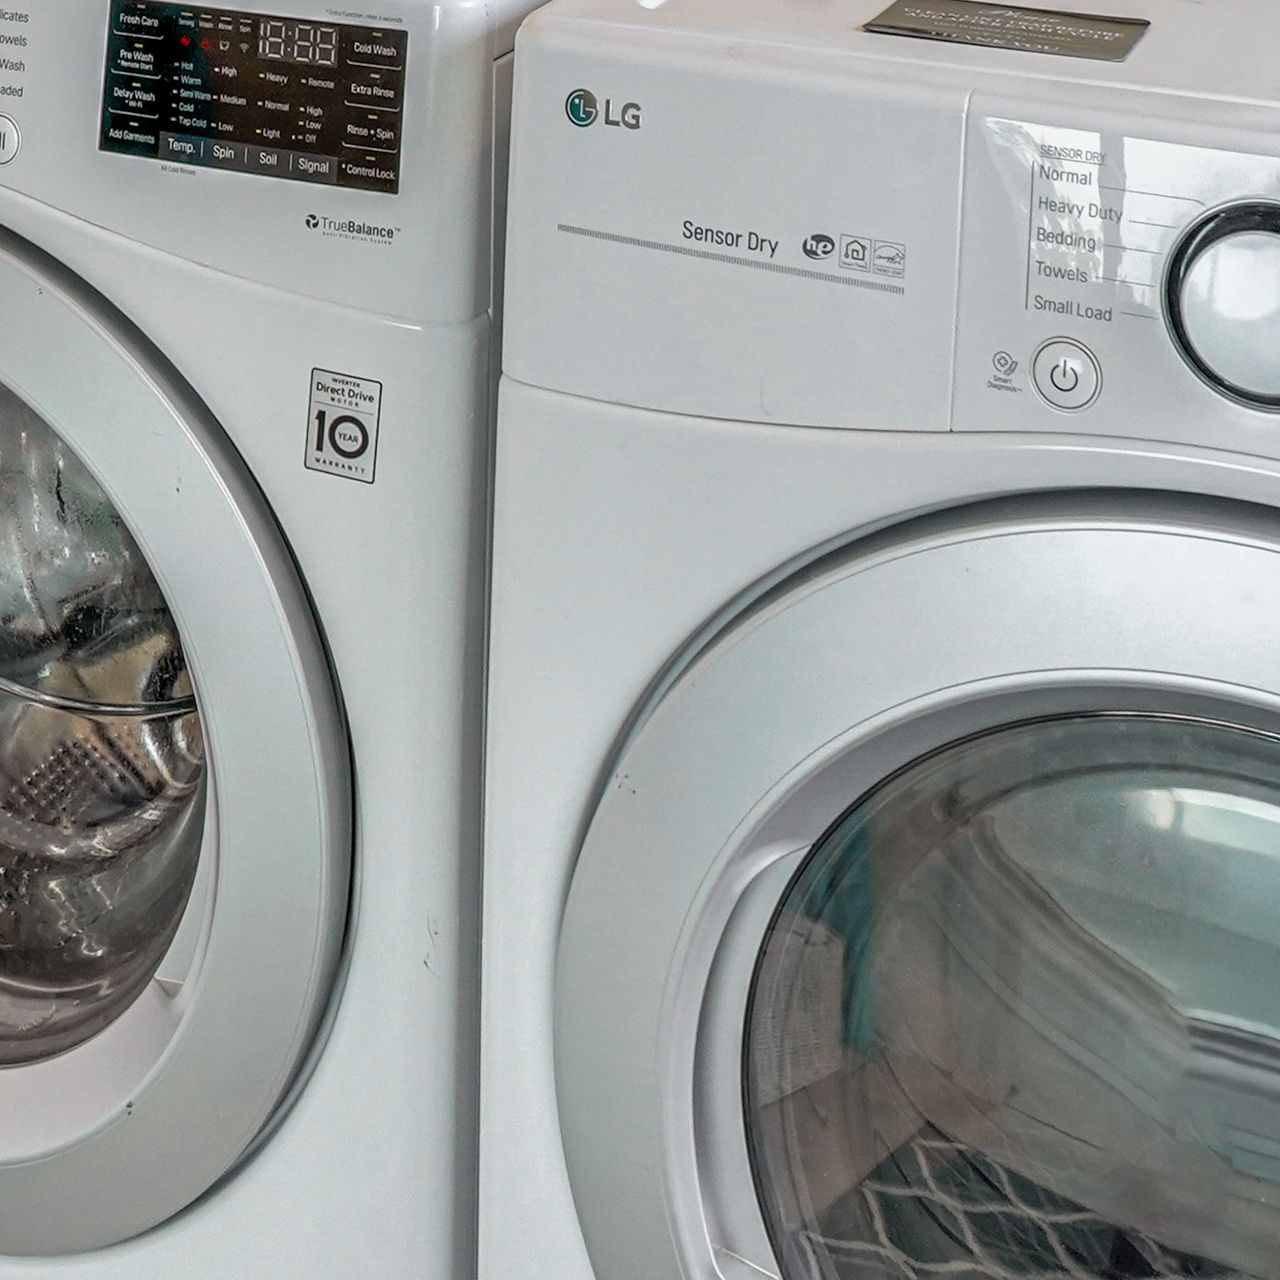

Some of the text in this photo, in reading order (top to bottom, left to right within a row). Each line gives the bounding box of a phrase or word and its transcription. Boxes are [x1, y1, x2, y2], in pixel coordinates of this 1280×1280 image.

[120, 12, 159, 27] Fresh Care
[120, 49, 154, 62] Pre Wash
[353, 42, 397, 56] Cold Wash
[0, 58, 25, 72] Wash
[221, 66, 238, 77] High
[181, 75, 202, 86] Warm
[266, 72, 289, 85] Heavy
[308, 78, 335, 89] Remote
[113, 87, 156, 102] Delay Wash
[351, 83, 395, 98] Extra Rinse
[220, 95, 247, 105] Medium
[264, 100, 290, 111] Normal
[179, 103, 195, 112] Cold
[306, 106, 323, 117] High
[604, 99, 642, 130] LG
[179, 117, 207, 128] Tap Cold
[218, 122, 234, 131] Low
[305, 120, 321, 130] Low
[108, 128, 155, 144] Add Garments
[263, 128, 281, 139] Light
[305, 134, 317, 143] Off
[346, 124, 394, 140] Rinse Spin
[168, 138, 196, 154] Temp.
[212, 144, 235, 159] Spin
[259, 152, 277, 166] Soil
[1040, 144, 1106, 163] SENSOR DRY
[298, 158, 329, 173] Signal
[346, 164, 395, 180] Control Lock
[1040, 165, 1092, 186] Normal
[1038, 196, 1123, 224] Heavy Duty
[682, 220, 779, 257] Sensor Dry
[1036, 227, 1097, 252] Bedding
[1036, 260, 1089, 283] Towels
[1034, 295, 1113, 321] Small Load
[331, 377, 361, 388] INVERTER
[316, 381, 375, 403] Direct Drive
[330, 397, 359, 407] MOTOR
[315, 409, 369, 459] 10
[337, 432, 359, 444] YEAR
[314, 456, 365, 474] WARRANTY
